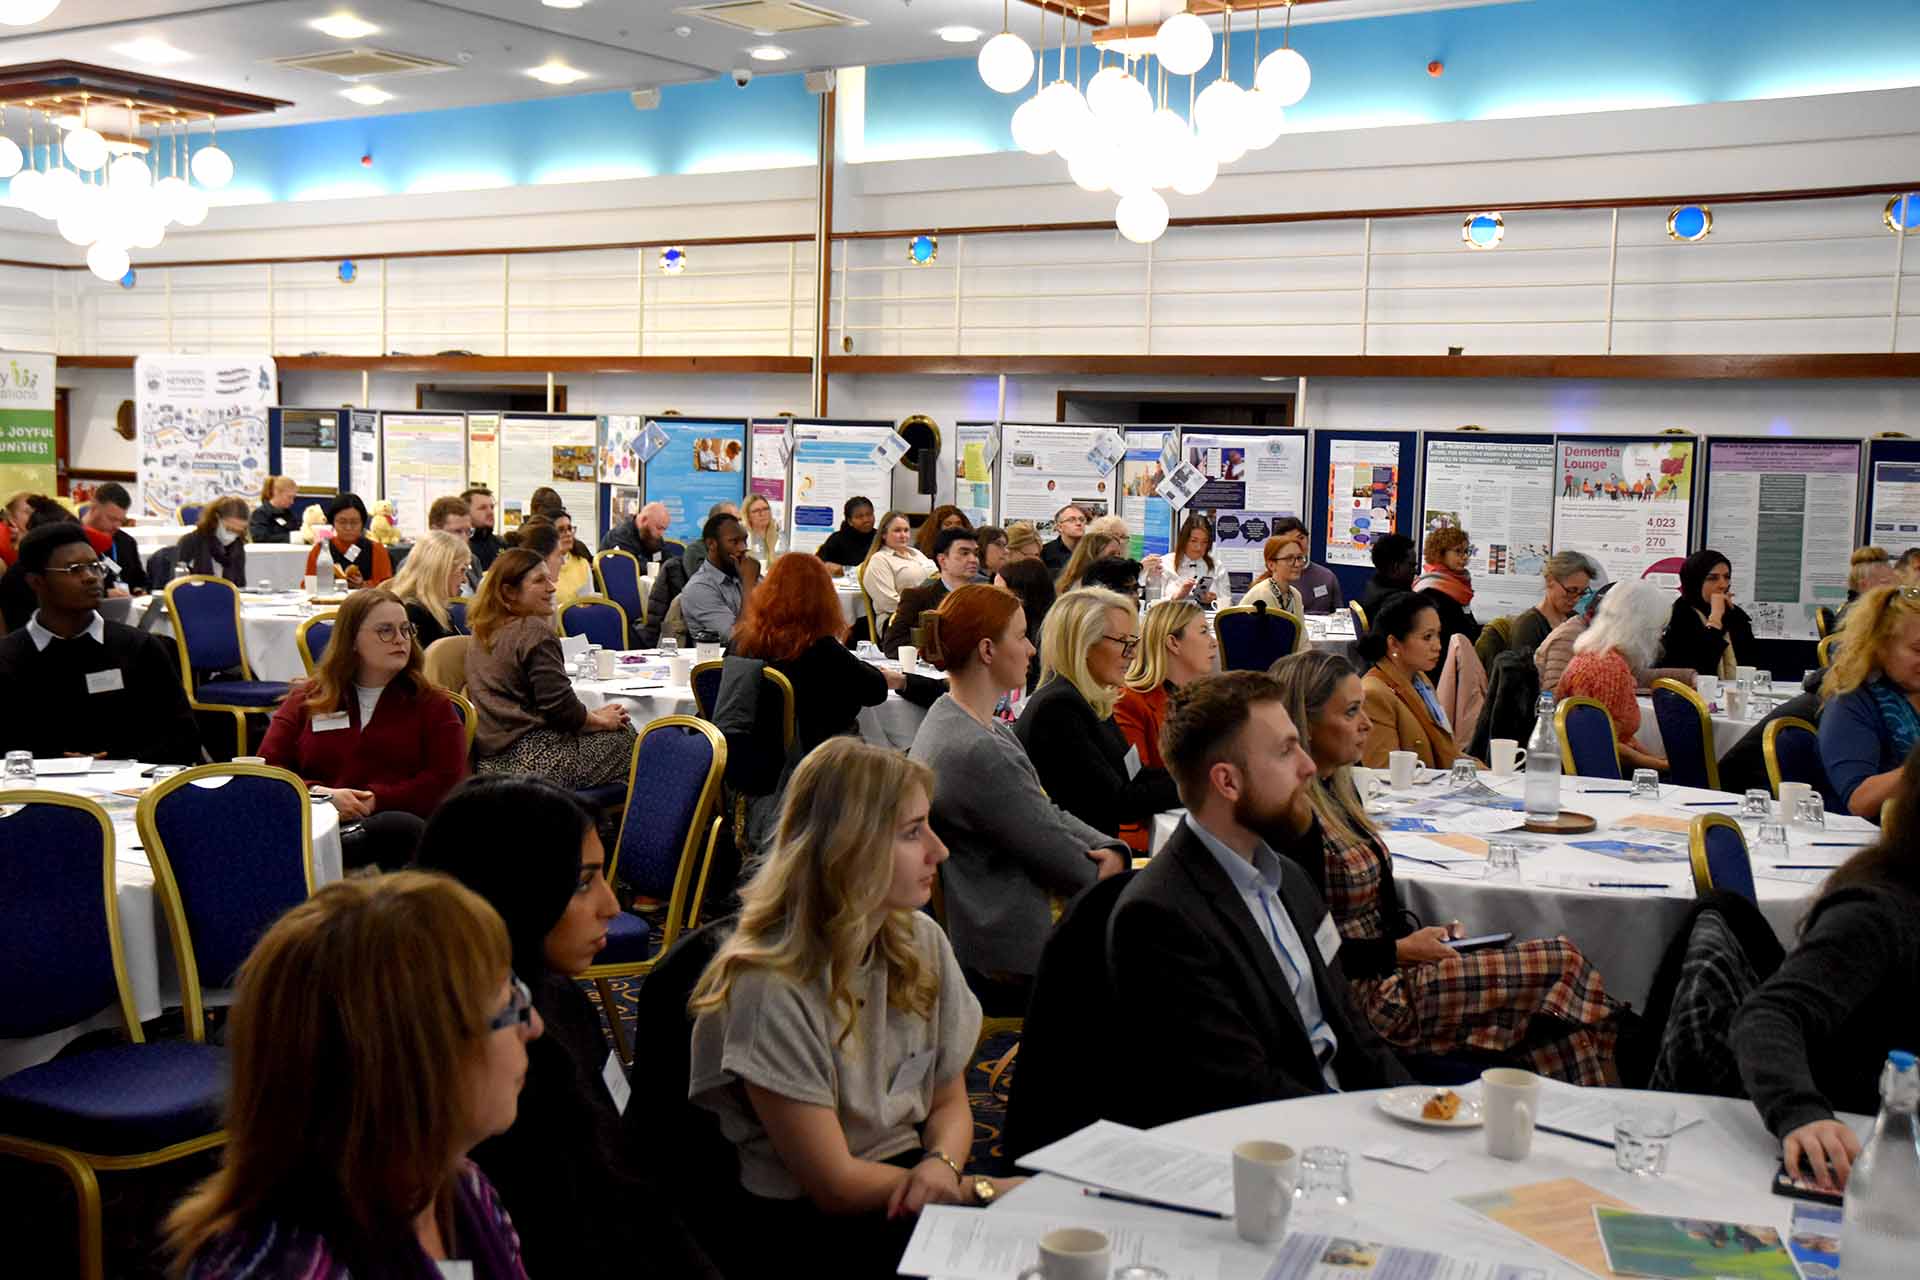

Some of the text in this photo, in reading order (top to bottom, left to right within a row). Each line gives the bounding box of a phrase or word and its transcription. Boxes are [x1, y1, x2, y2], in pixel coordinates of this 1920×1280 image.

[1564, 446, 1620, 457] Dementia
[1564, 460, 1607, 472] Lounge
[1647, 518, 1676, 529] 4,023
[1646, 537, 1666, 547] 270
